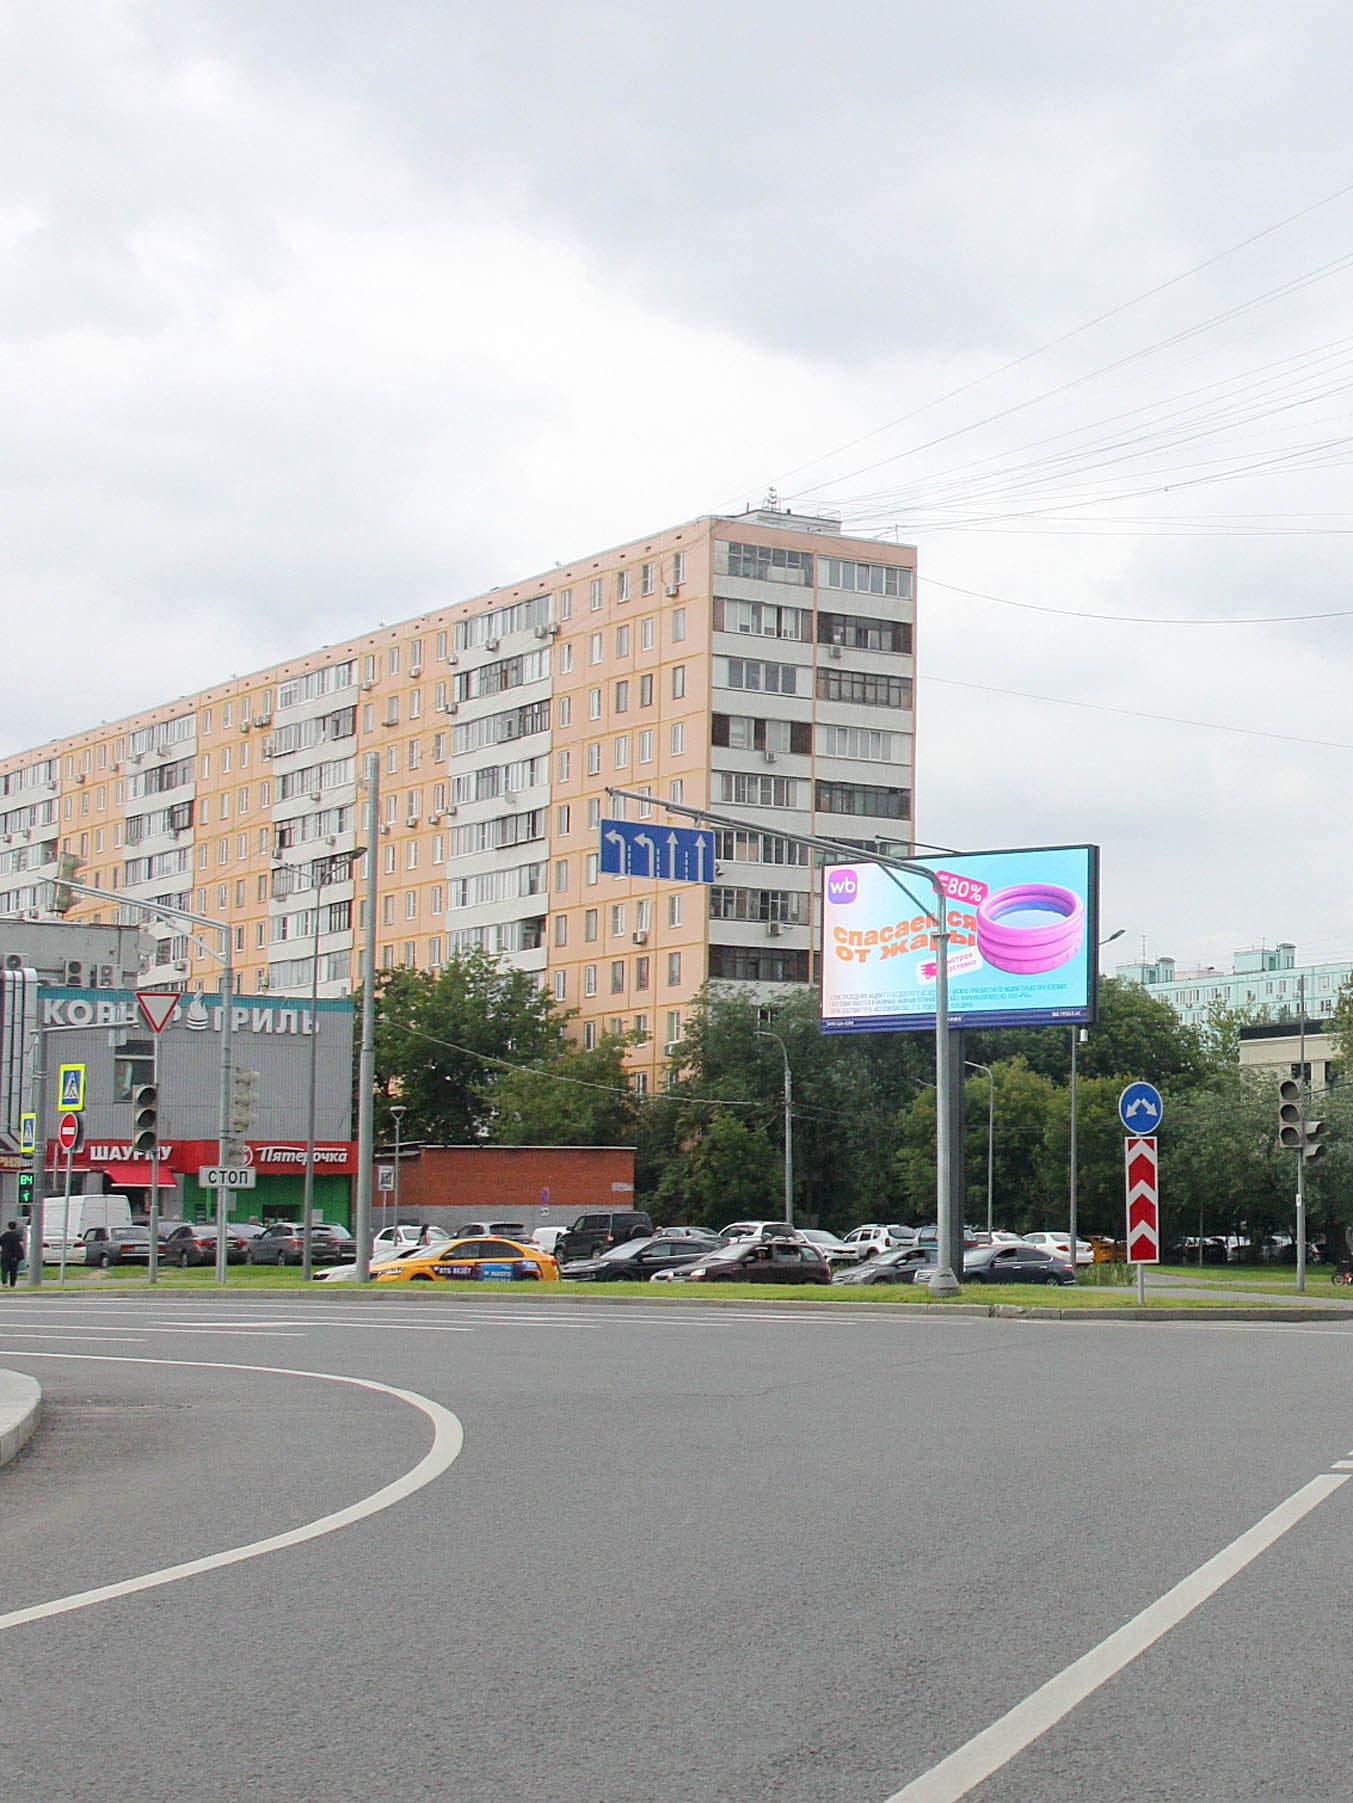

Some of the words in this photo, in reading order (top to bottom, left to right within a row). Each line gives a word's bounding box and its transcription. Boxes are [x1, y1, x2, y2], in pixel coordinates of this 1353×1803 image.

[830, 876, 856, 894] wb
[941, 877, 983, 902] -80%
[833, 910, 976, 946] спасаемся
[835, 946, 870, 963] от
[880, 930, 975, 960] жары
[214, 1006, 320, 1035] ГРИЛЬ
[208, 1170, 248, 1184] СТОП
